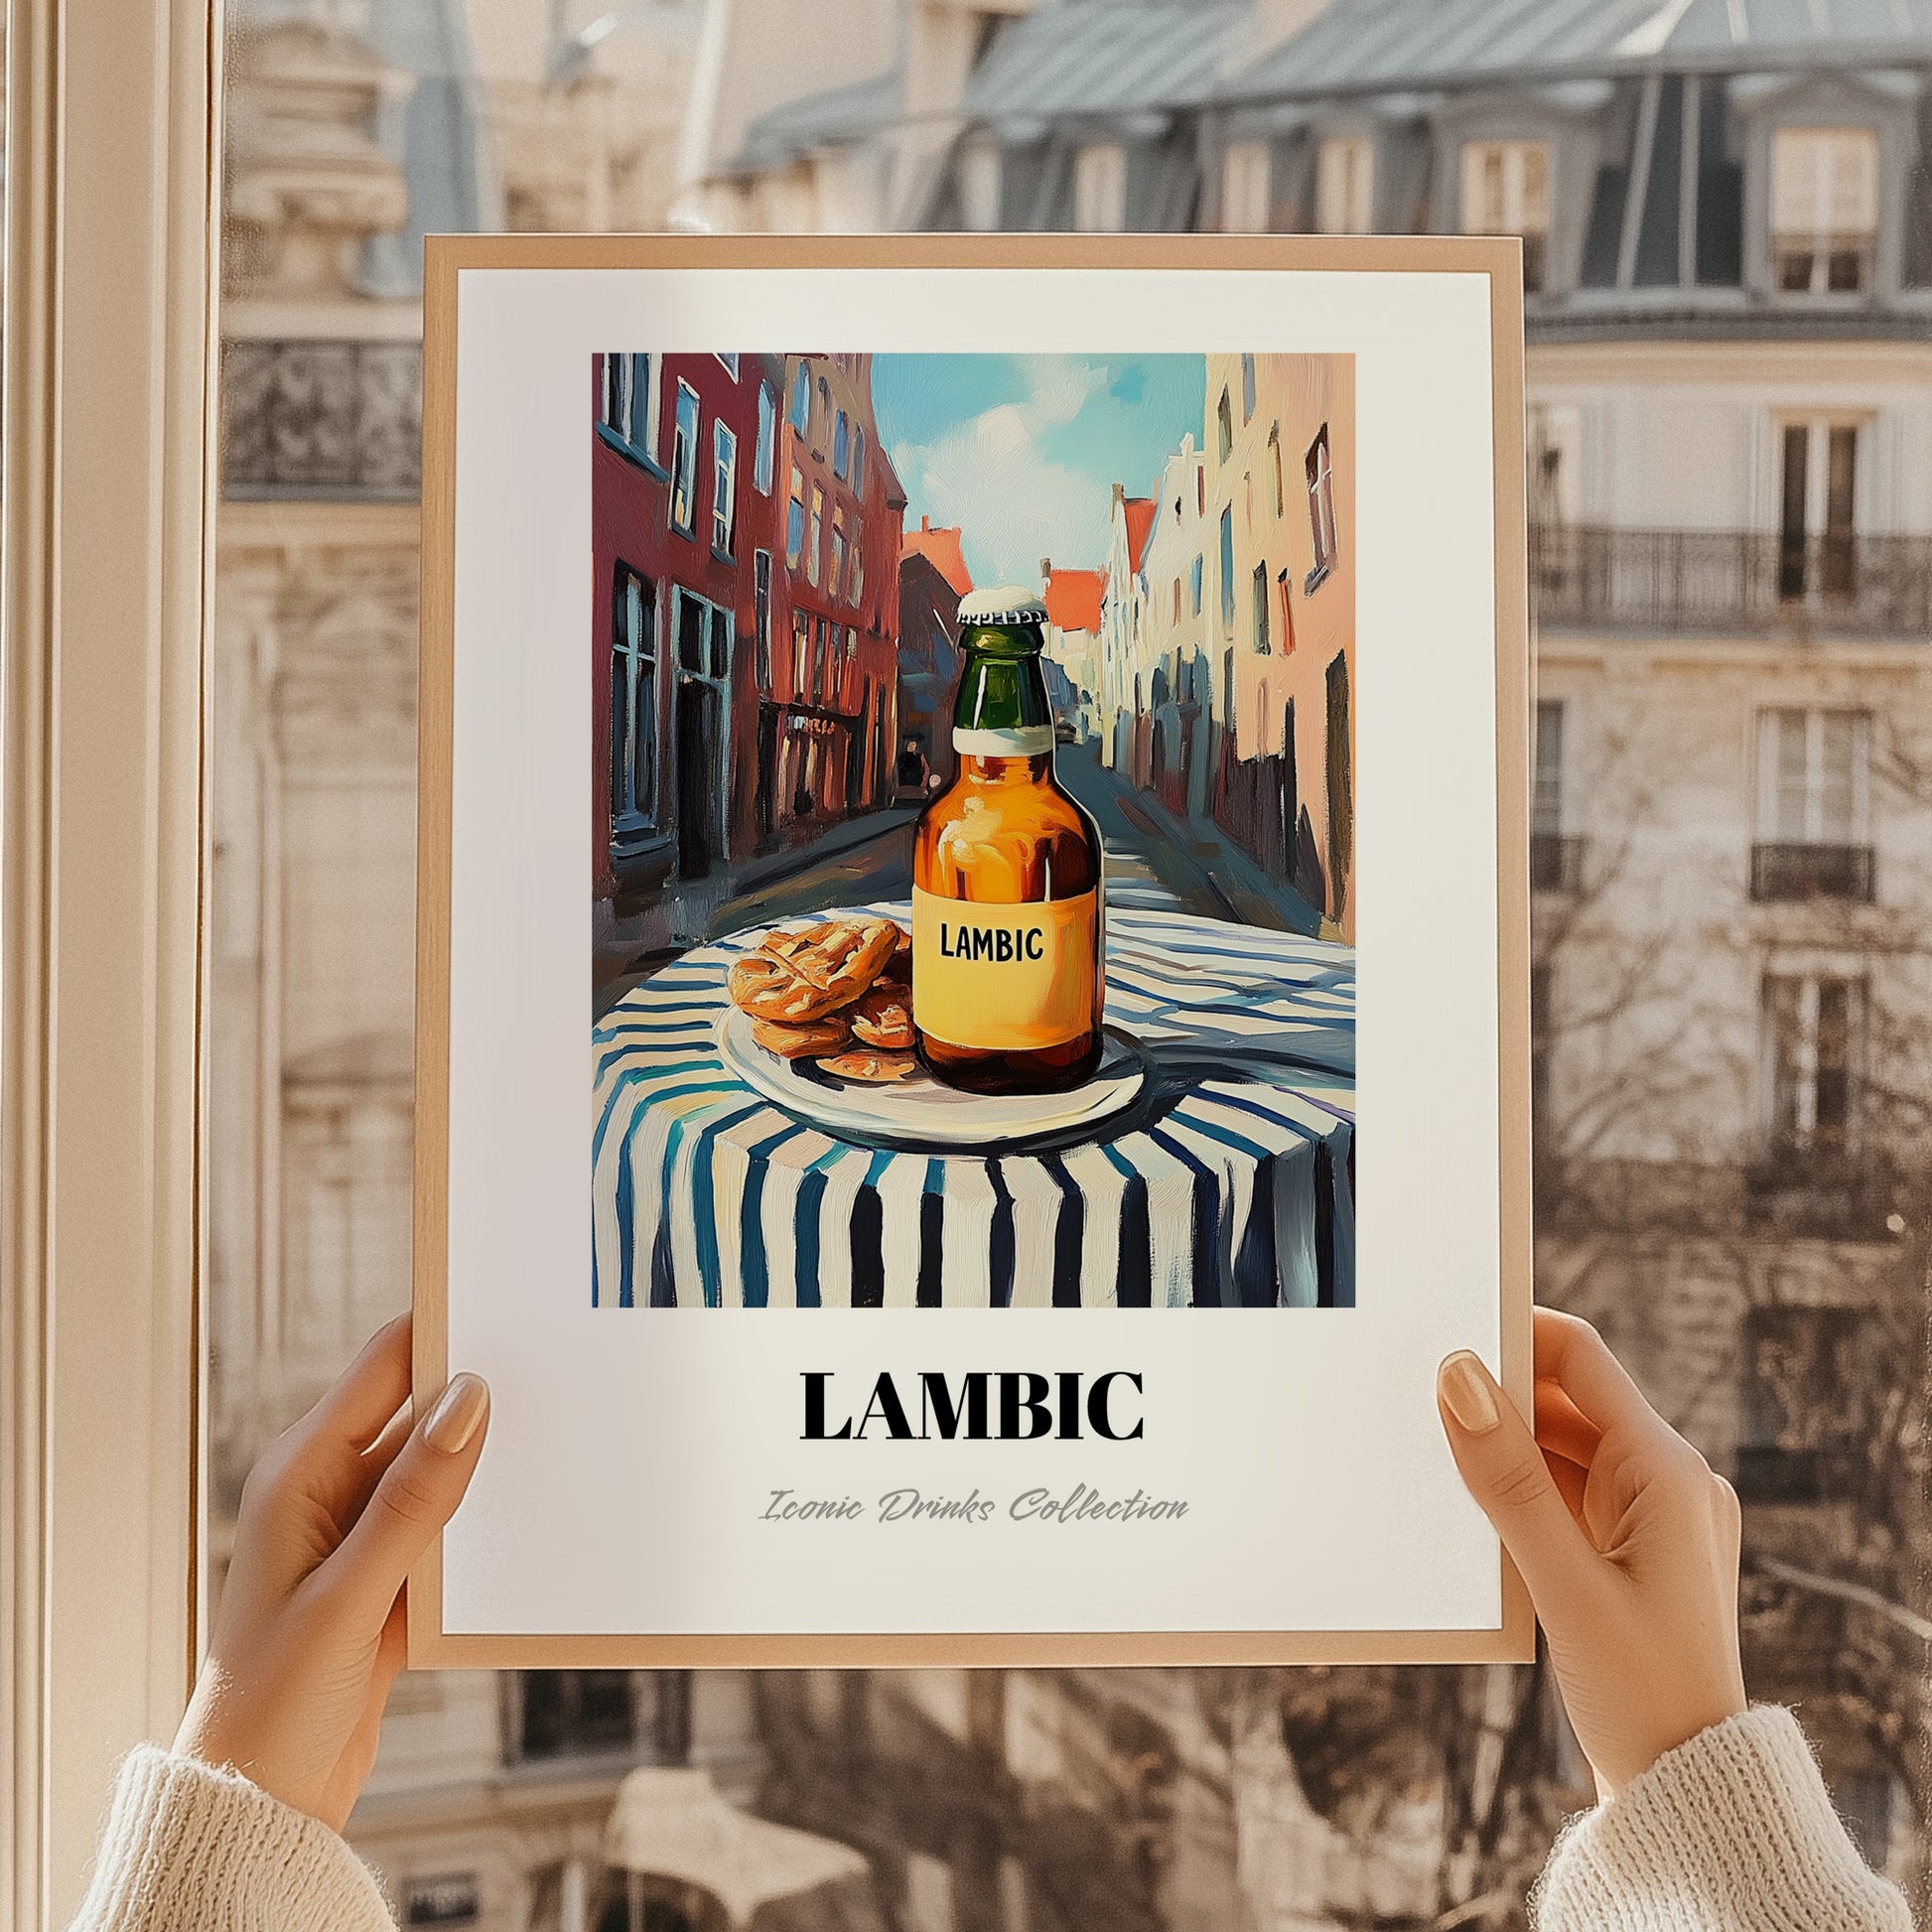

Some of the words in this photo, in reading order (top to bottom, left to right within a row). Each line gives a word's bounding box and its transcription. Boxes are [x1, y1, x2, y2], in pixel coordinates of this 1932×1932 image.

[941, 923, 1043, 962] LAMBIC
[799, 1371, 1144, 1442] LAMBIC
[758, 1488, 866, 1521] Iconic
[879, 1488, 996, 1523] Drinks
[1009, 1482, 1190, 1524] Collection
